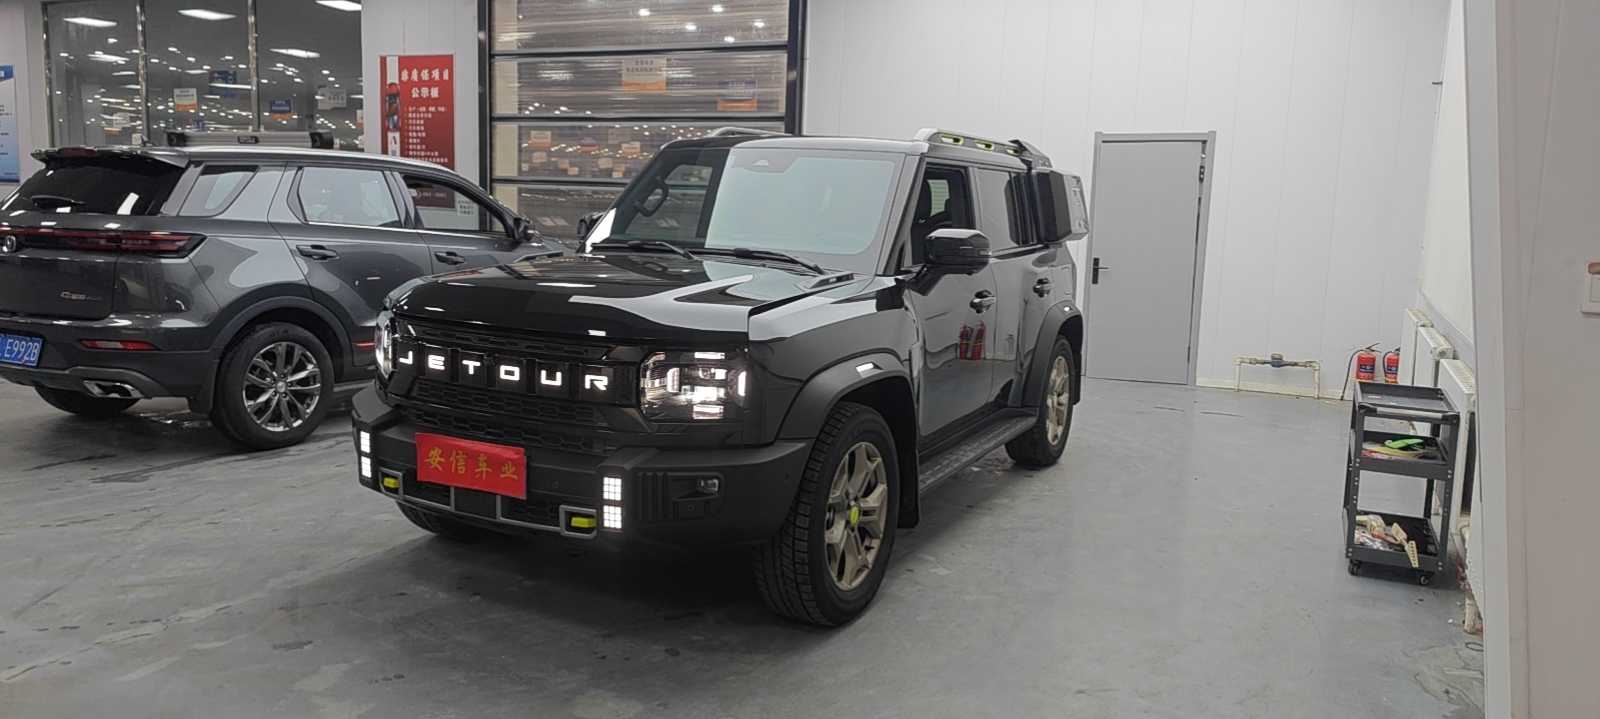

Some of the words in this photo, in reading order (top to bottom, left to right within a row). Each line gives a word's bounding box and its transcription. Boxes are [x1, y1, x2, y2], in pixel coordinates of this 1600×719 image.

[399, 350, 609, 391] JETOUR
[424, 446, 519, 480] 安信车业
